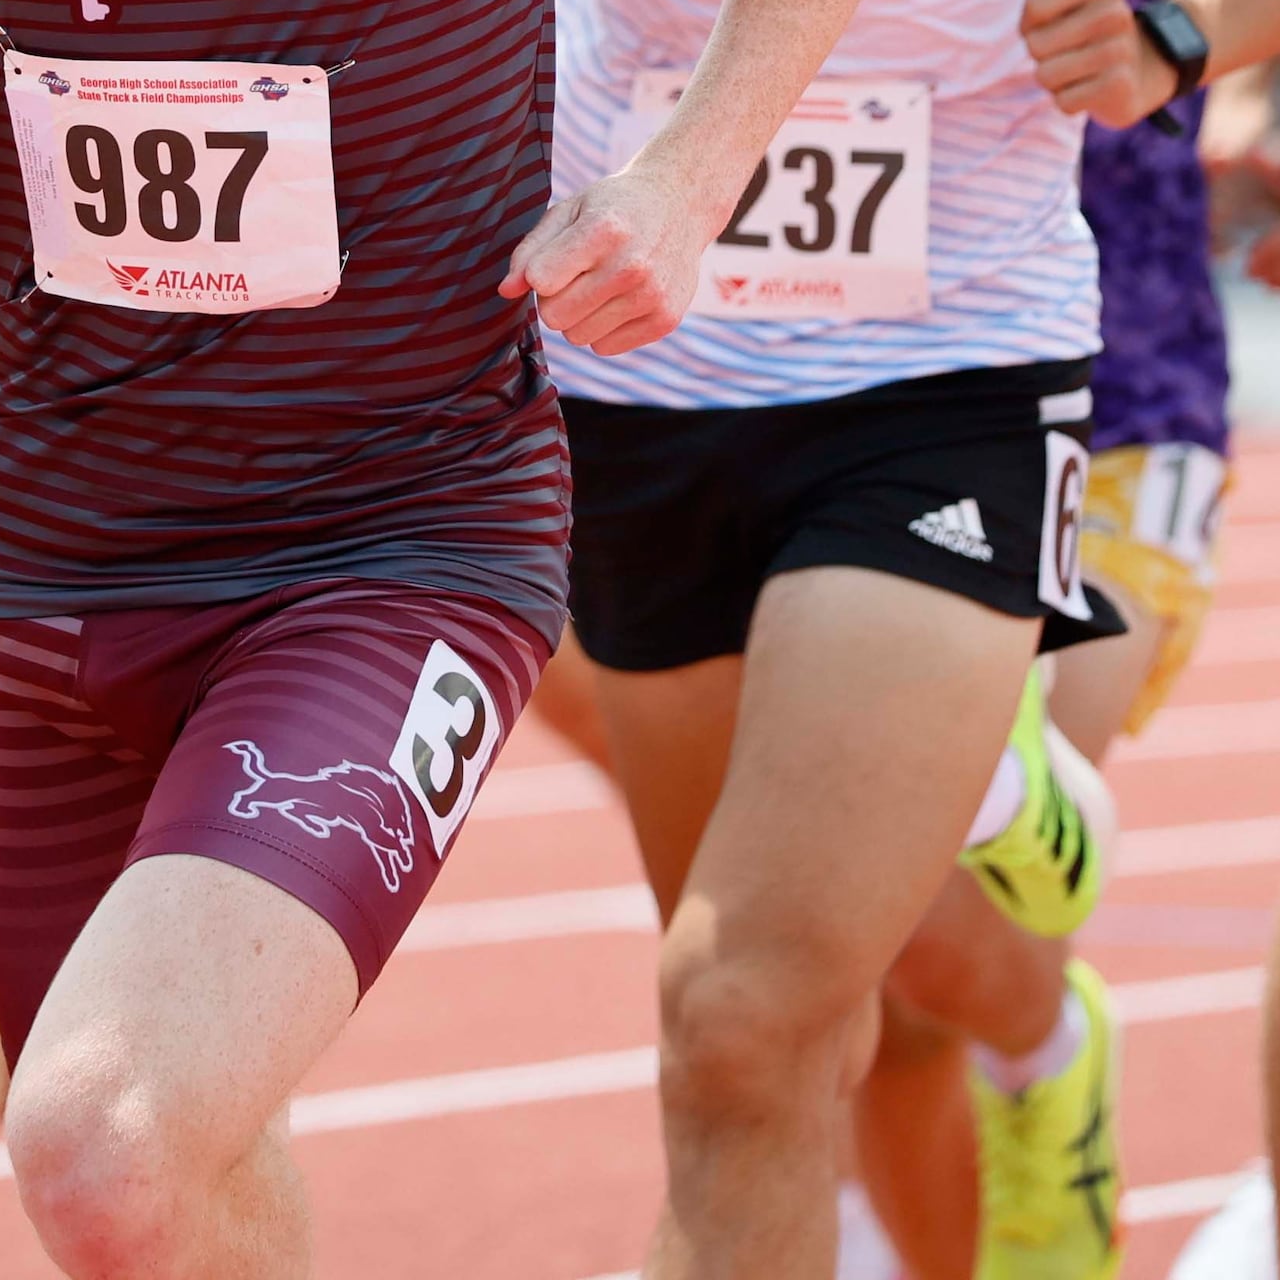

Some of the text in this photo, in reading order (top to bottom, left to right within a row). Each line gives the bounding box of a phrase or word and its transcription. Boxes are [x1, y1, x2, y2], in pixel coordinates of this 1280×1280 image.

[80, 77, 238, 90] Georgia High School Association
[77, 90, 244, 105] State Track & Field Championships
[65, 124, 269, 243] 987
[155, 269, 248, 292] ATLANTA
[156, 289, 250, 301] TRACK CLUB
[411, 671, 486, 818] 3
